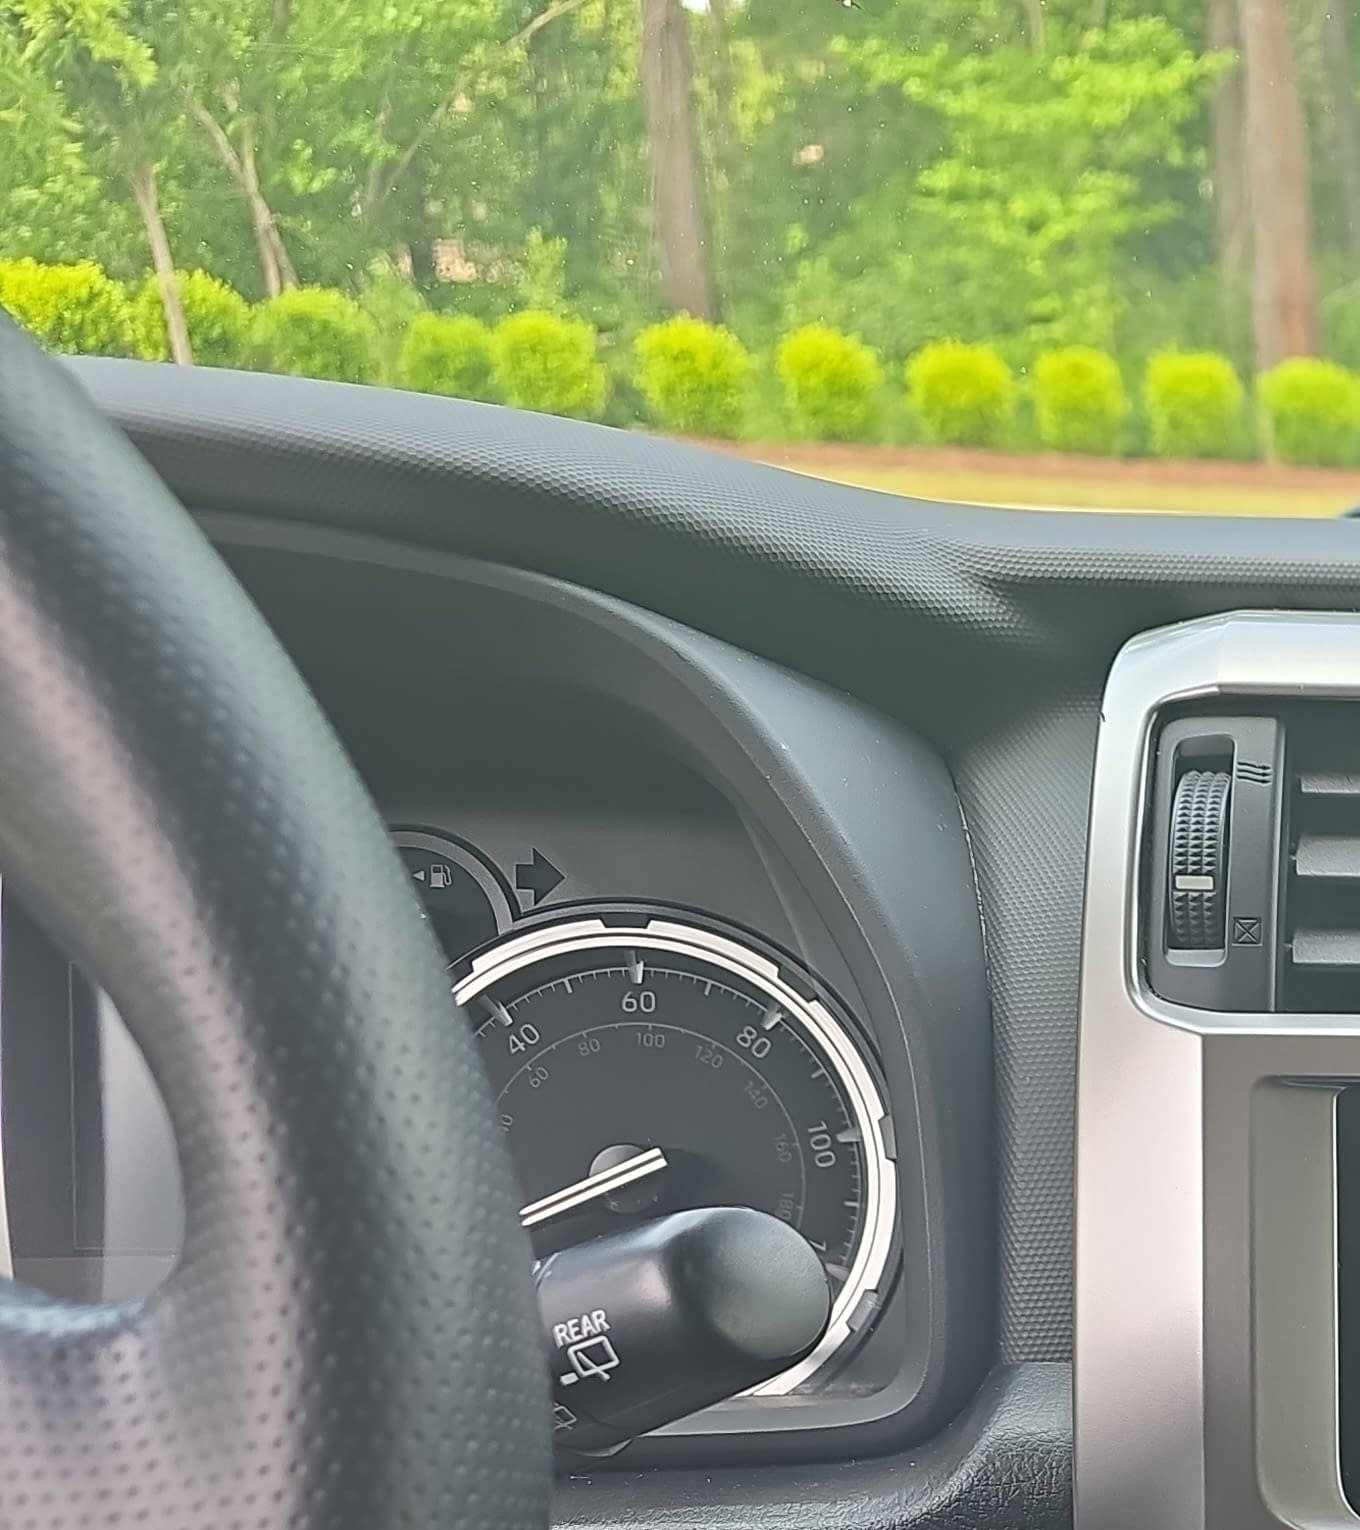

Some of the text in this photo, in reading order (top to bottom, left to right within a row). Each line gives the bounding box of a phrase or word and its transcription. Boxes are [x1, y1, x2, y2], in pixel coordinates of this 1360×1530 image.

[622, 991, 656, 1013] 60
[508, 1023, 540, 1054] 40
[577, 1037, 600, 1057] 80
[636, 1031, 666, 1048] 100
[736, 1026, 771, 1059] 80
[695, 1045, 724, 1069] 120
[527, 1066, 549, 1088] 60
[807, 1120, 836, 1168] 100
[554, 1309, 611, 1349] REAR
